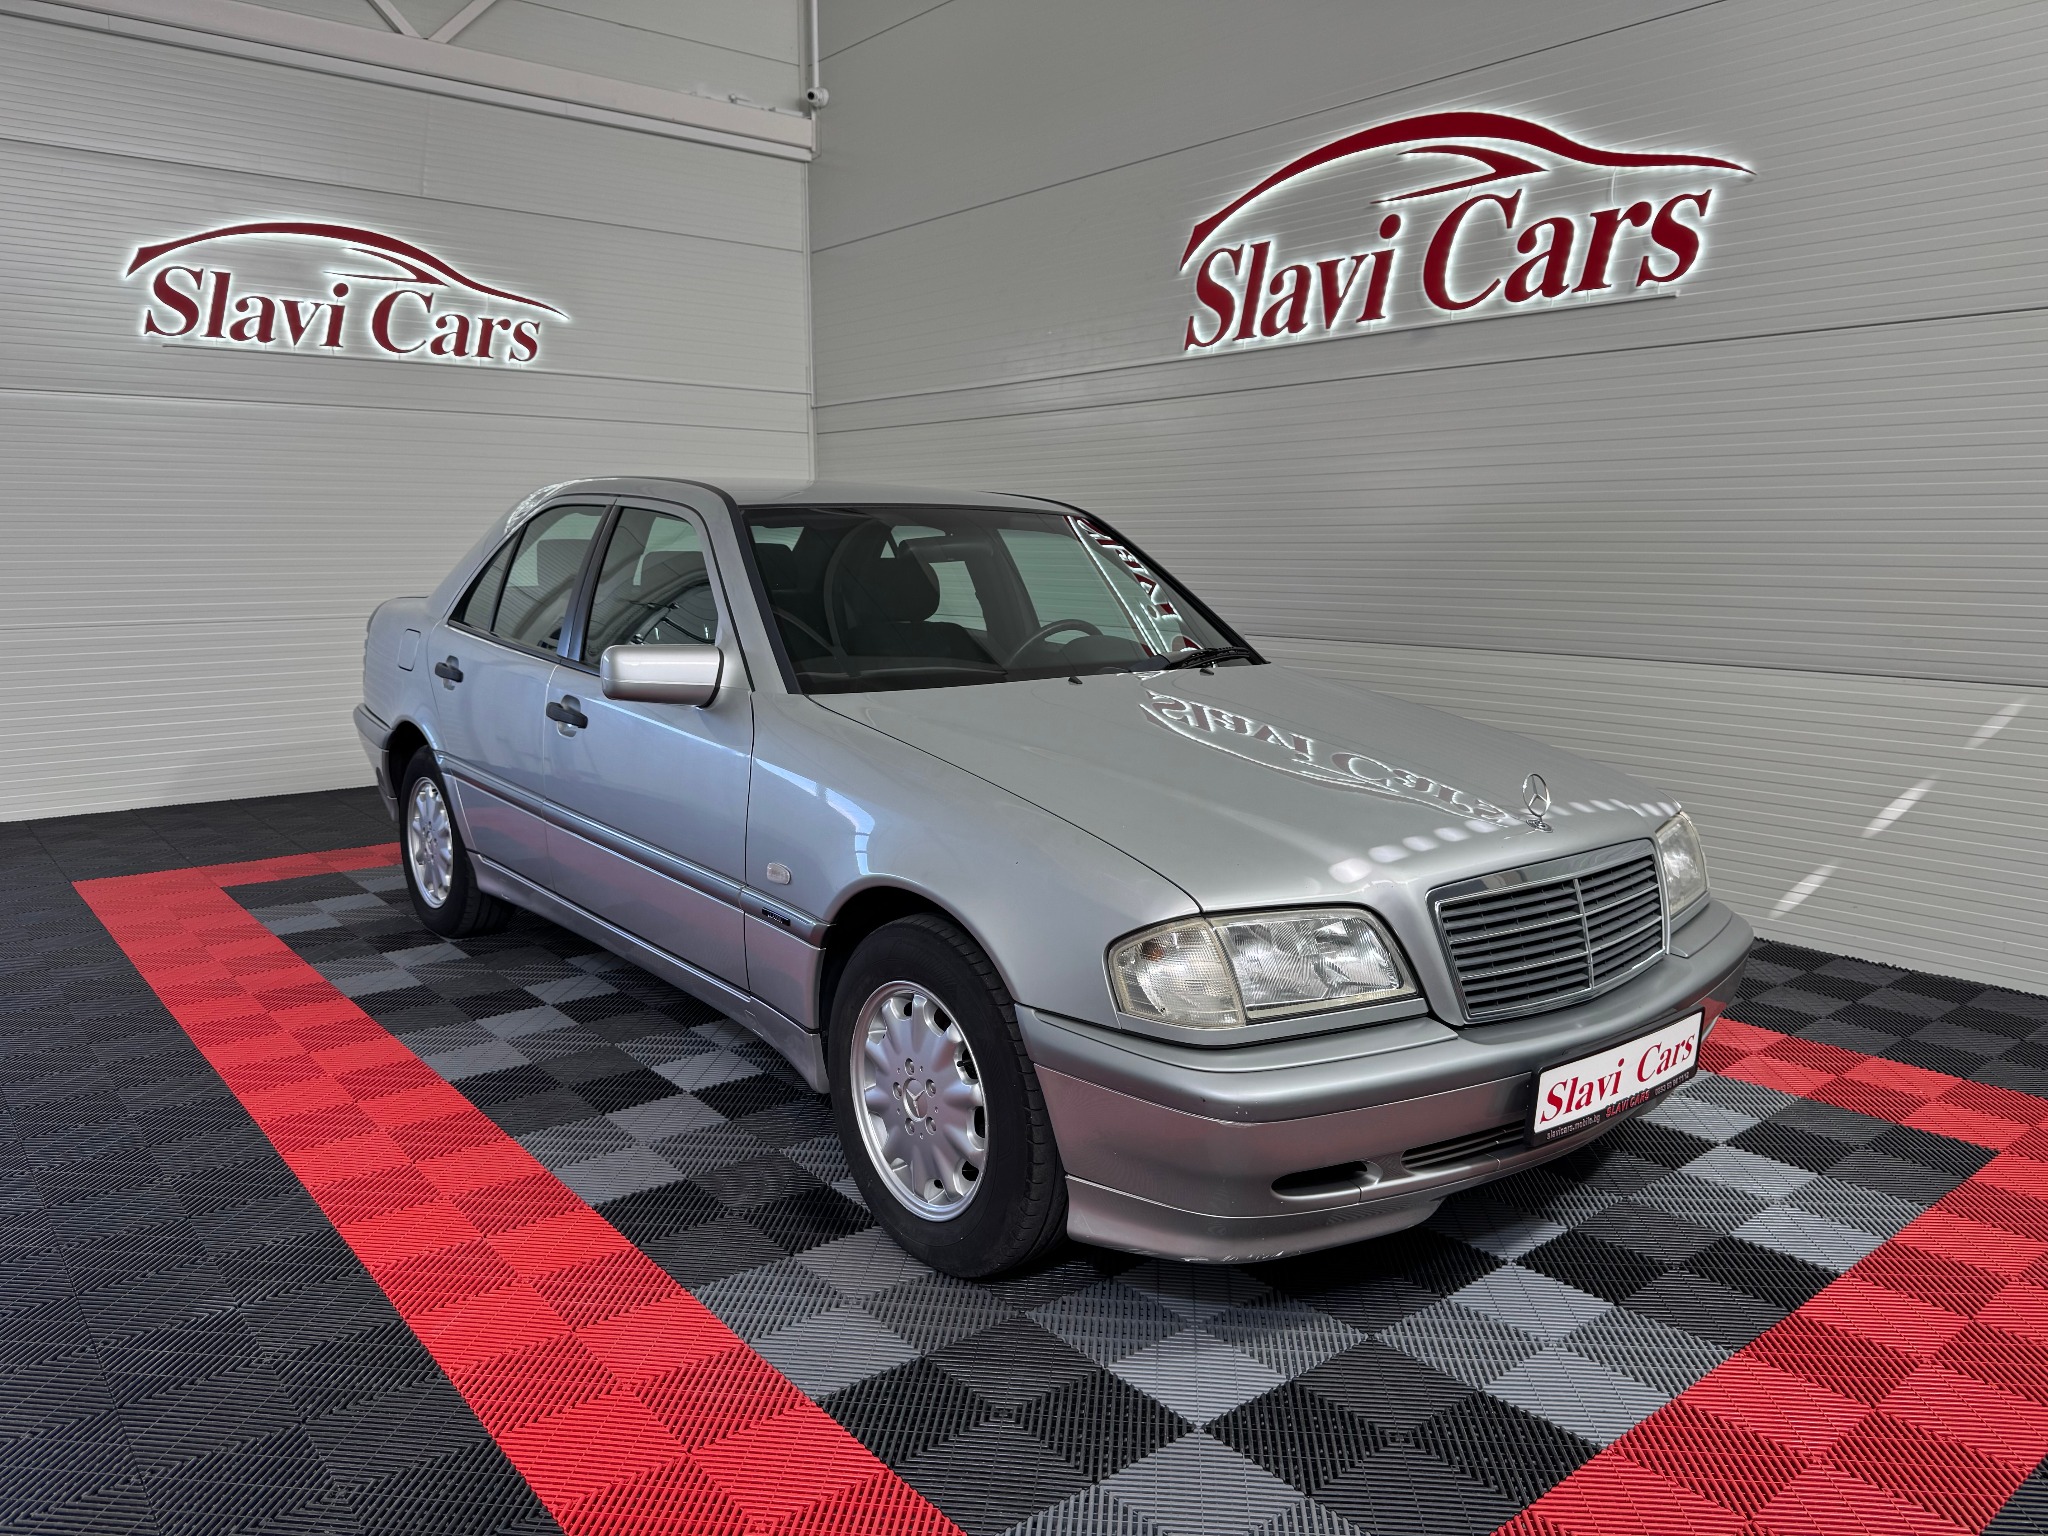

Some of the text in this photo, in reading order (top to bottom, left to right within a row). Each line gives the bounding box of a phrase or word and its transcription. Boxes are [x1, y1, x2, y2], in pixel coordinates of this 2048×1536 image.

[144, 265, 541, 362] Slavi Cars
[1184, 189, 1713, 351] Slavi Cars
[1540, 1034, 1696, 1124] Slavi Cars
[1606, 1098, 1629, 1117] SLAVI
[1629, 1089, 1650, 1108] CARS
